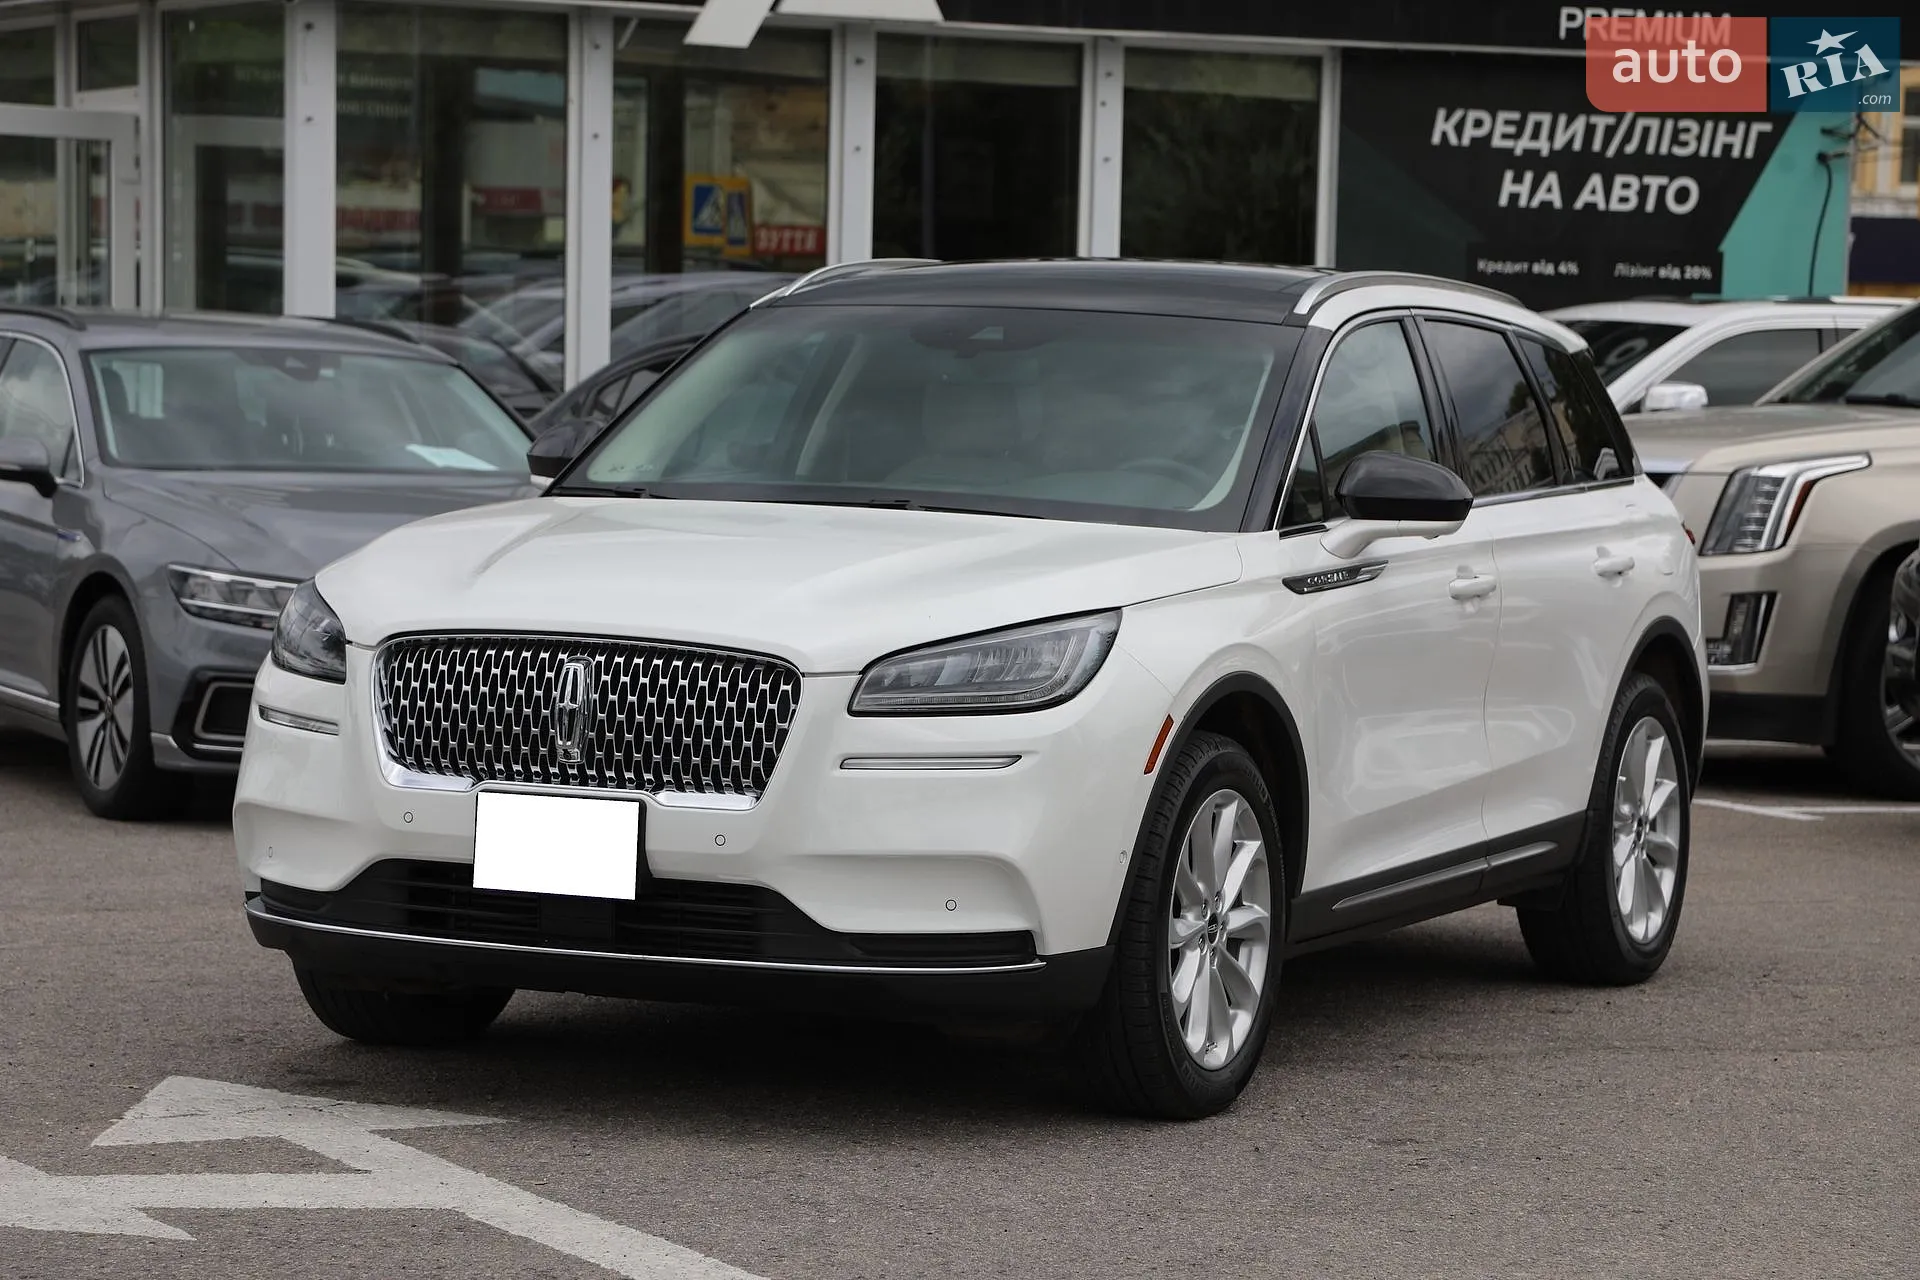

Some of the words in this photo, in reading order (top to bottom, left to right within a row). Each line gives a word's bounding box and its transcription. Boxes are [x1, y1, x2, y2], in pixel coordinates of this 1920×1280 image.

[1558, 7, 1732, 46] PREMIUM
[1431, 107, 1773, 159] КРЕДИТ/ЛІЗІНГ
[1498, 169, 1563, 210] НА
[1573, 172, 1700, 215] АВТО
